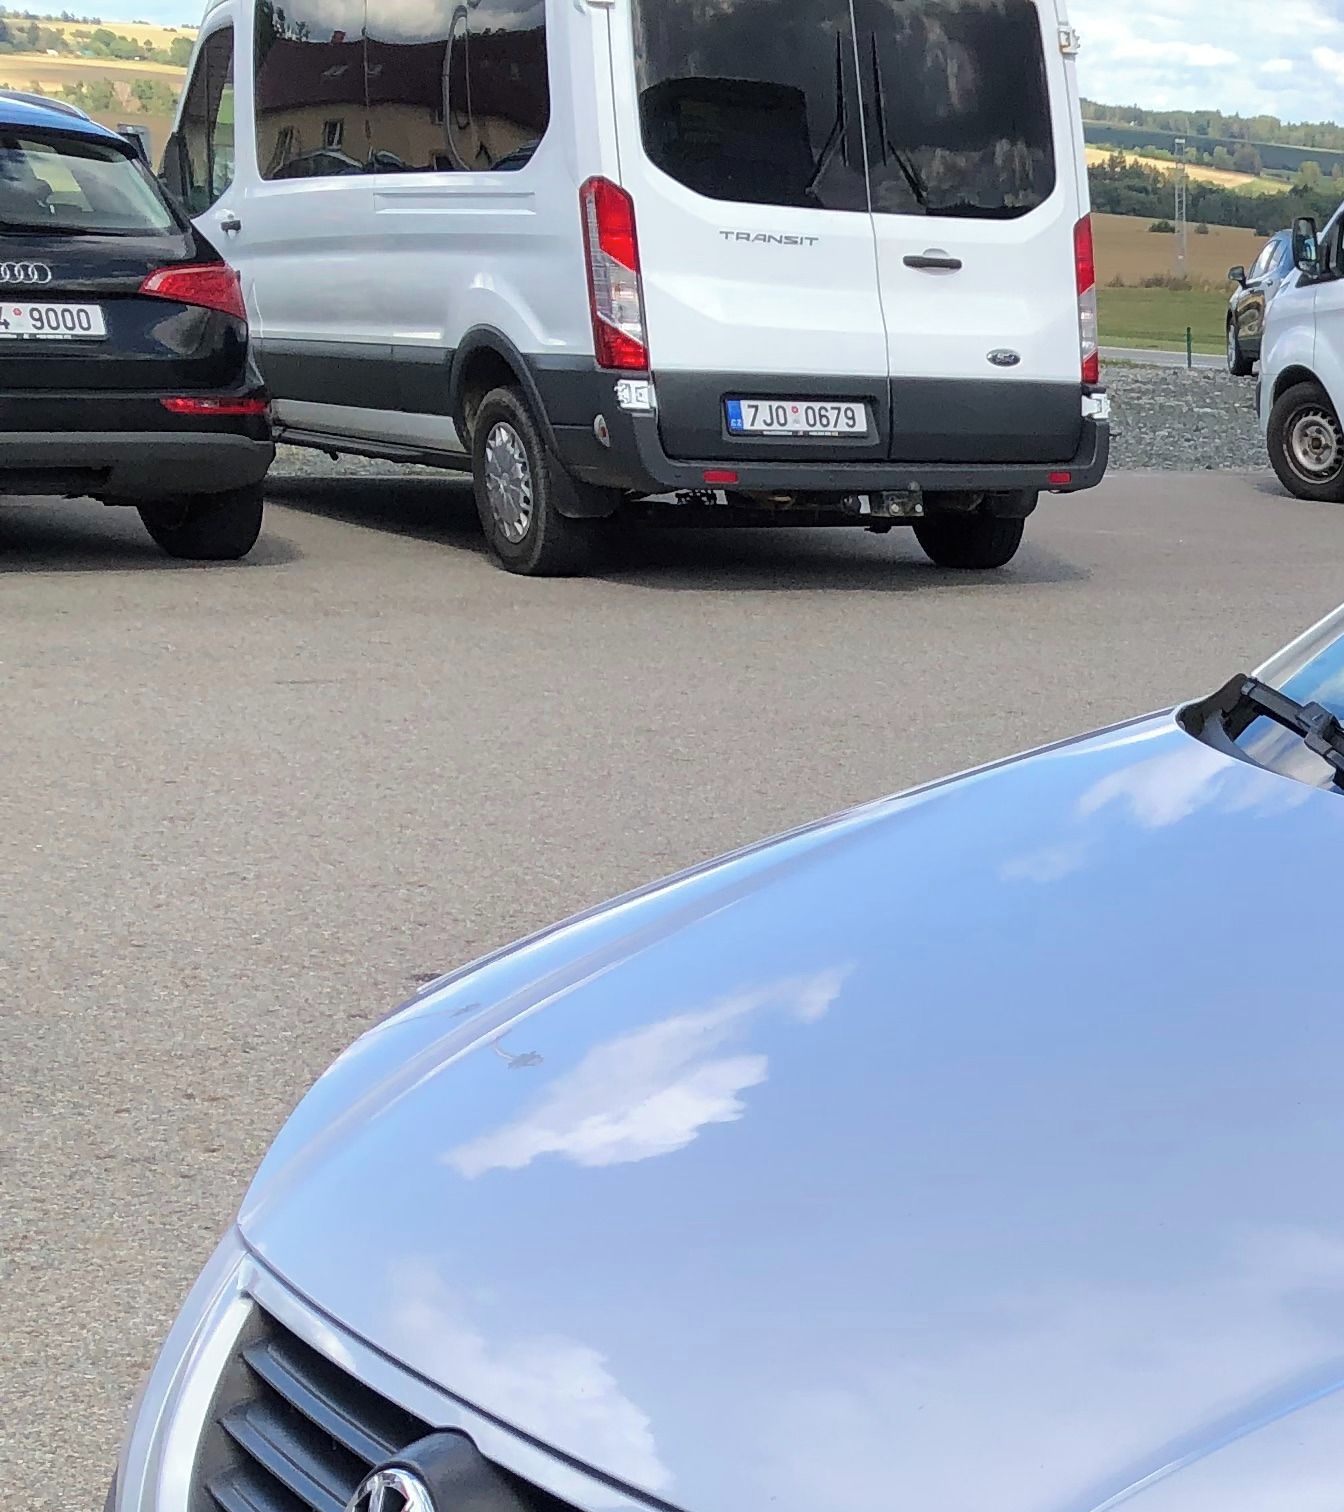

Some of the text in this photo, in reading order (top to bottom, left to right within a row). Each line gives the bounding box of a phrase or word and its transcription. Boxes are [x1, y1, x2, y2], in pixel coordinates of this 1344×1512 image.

[719, 230, 819, 246] TRANSIT
[29, 307, 92, 331] 9000
[804, 405, 856, 428] 0679
